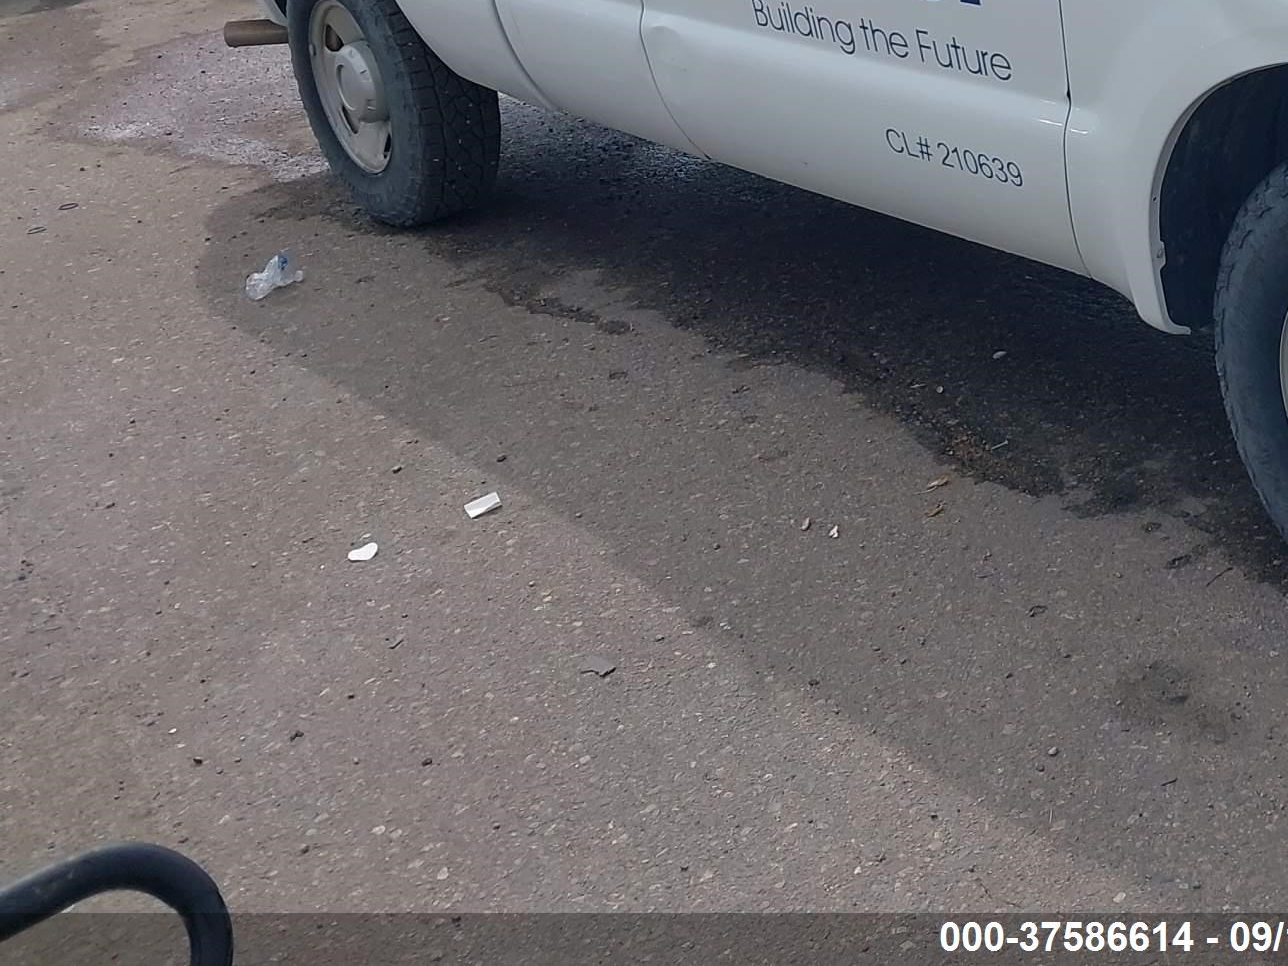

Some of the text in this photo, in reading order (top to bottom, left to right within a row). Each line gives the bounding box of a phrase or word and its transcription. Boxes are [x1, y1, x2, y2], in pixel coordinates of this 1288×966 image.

[859, 17, 909, 59] the
[916, 29, 1012, 81] Future
[885, 128, 1023, 187] CL# 210639
